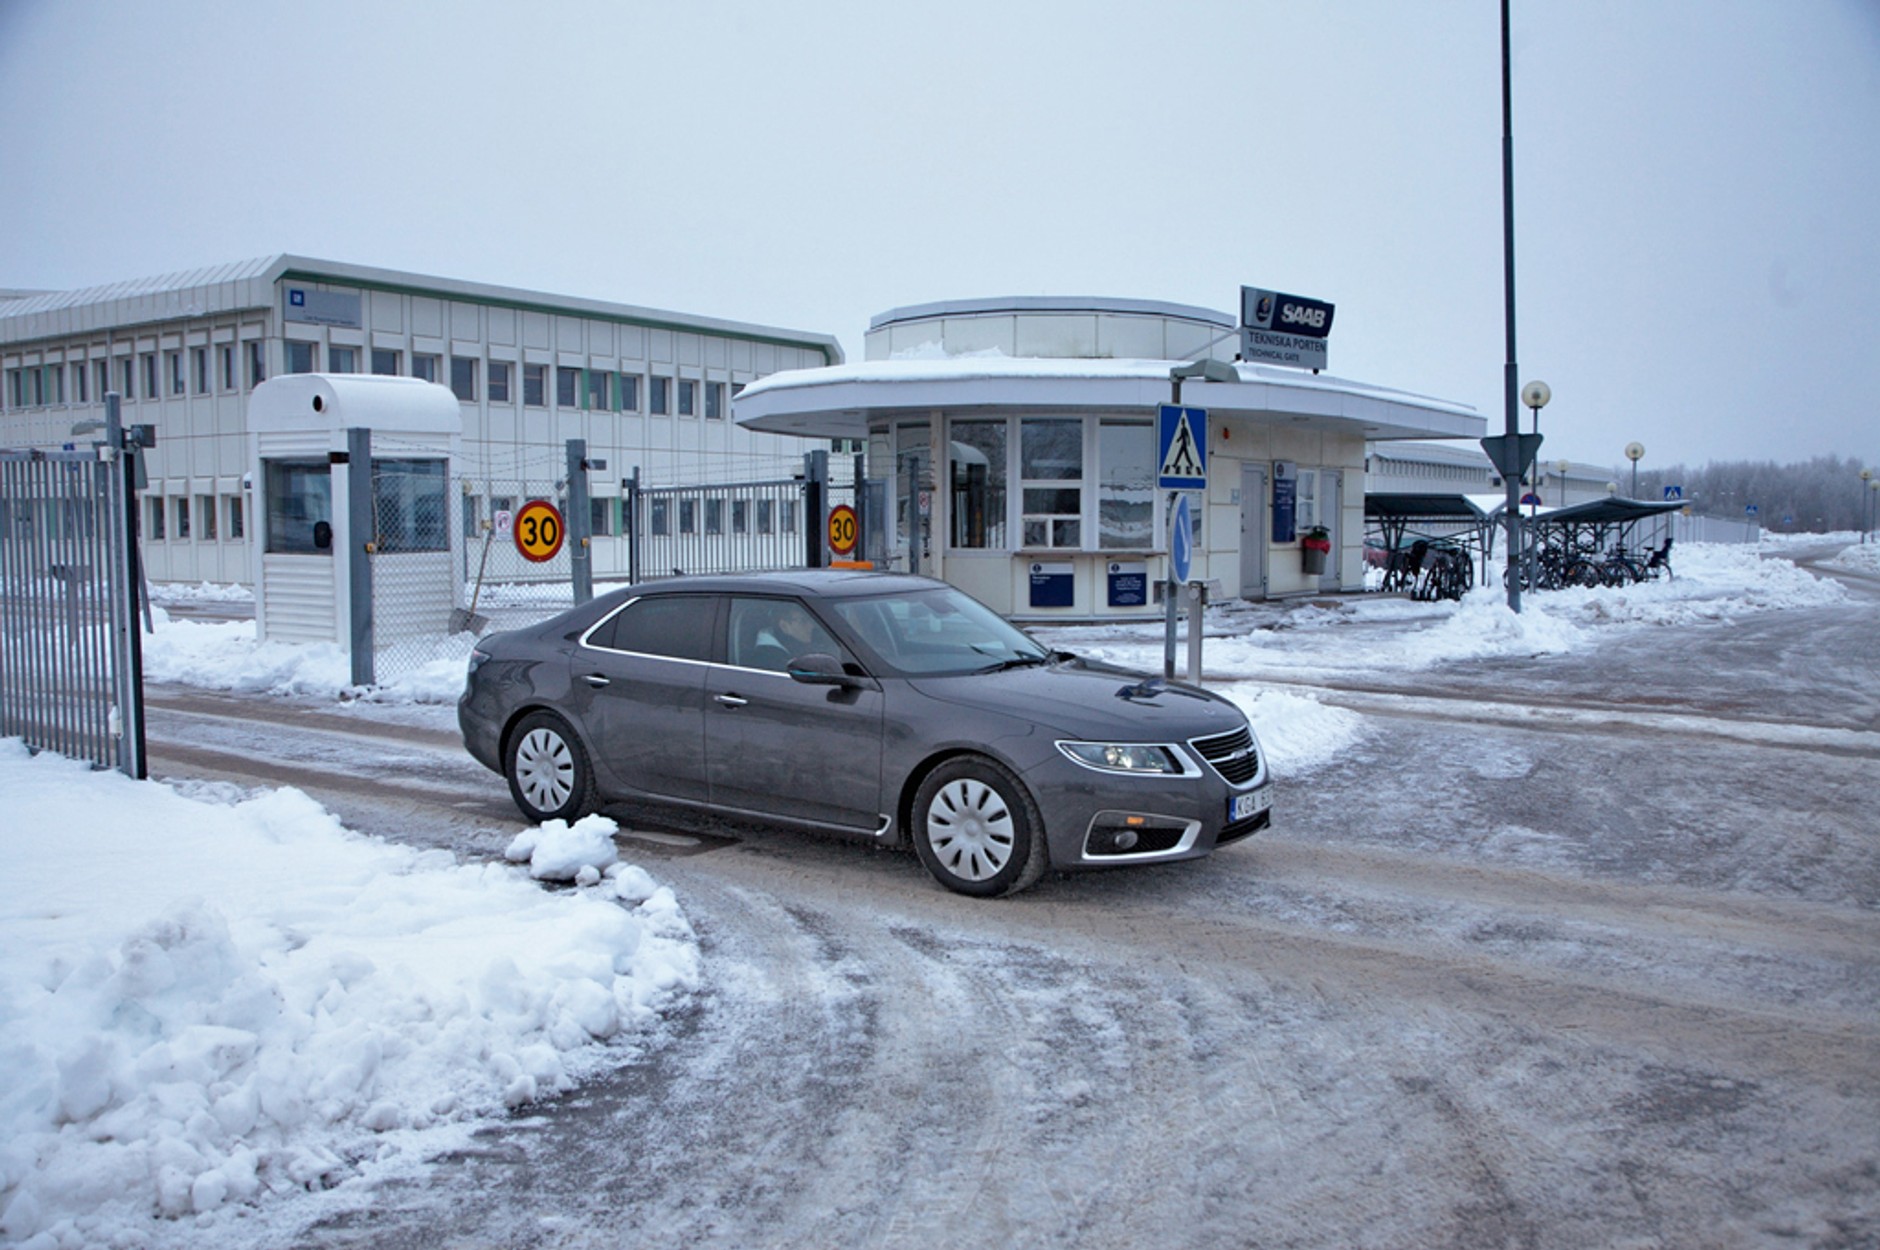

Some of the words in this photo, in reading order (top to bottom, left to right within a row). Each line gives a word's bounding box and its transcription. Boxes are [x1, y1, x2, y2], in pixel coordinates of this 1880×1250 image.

[1281, 303, 1326, 328] SAAB
[1248, 331, 1292, 349] TEKNISKA
[1293, 337, 1327, 353] PORTEN
[1248, 347, 1283, 361] TECHNICAL
[1284, 352, 1300, 362] GATE
[523, 516, 557, 546] 30
[832, 517, 855, 542] 30
